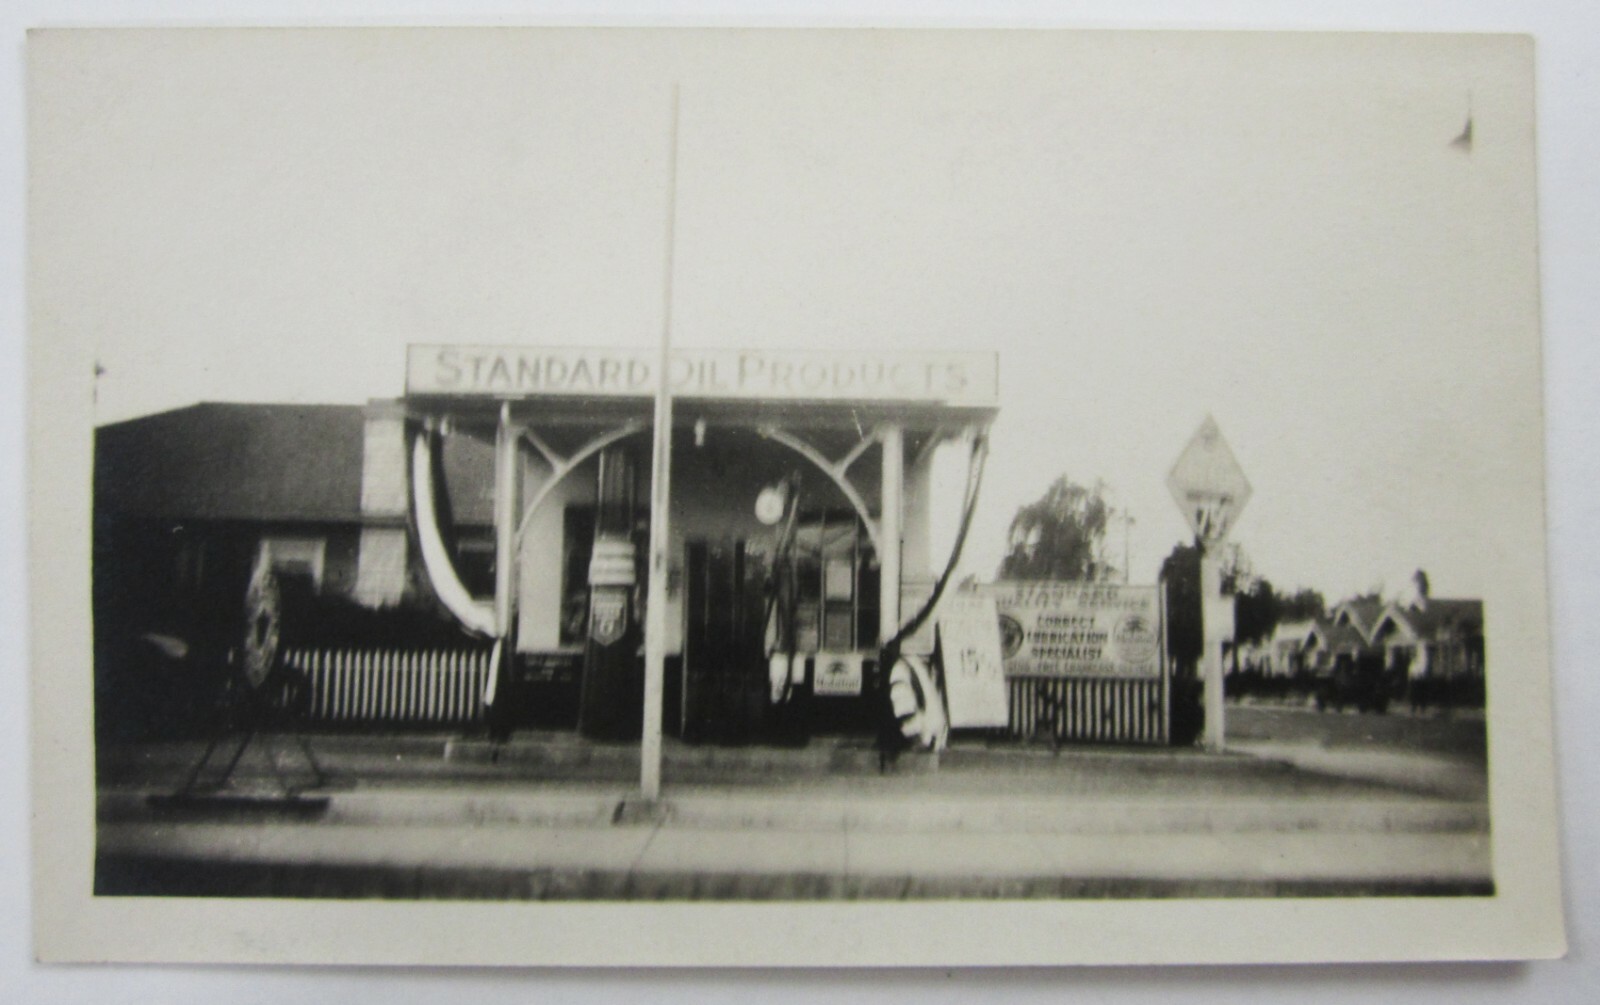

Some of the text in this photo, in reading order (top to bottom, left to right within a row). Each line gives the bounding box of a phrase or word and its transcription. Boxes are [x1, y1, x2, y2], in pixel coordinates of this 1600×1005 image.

[434, 348, 650, 388] STANDARD
[737, 353, 970, 394] PRODUCTS
[996, 598, 1063, 610] UALITY
[1037, 616, 1096, 629] CORRECT
[1027, 631, 1109, 644] LUBRICATION
[1032, 647, 1103, 660] SPECIALIST
